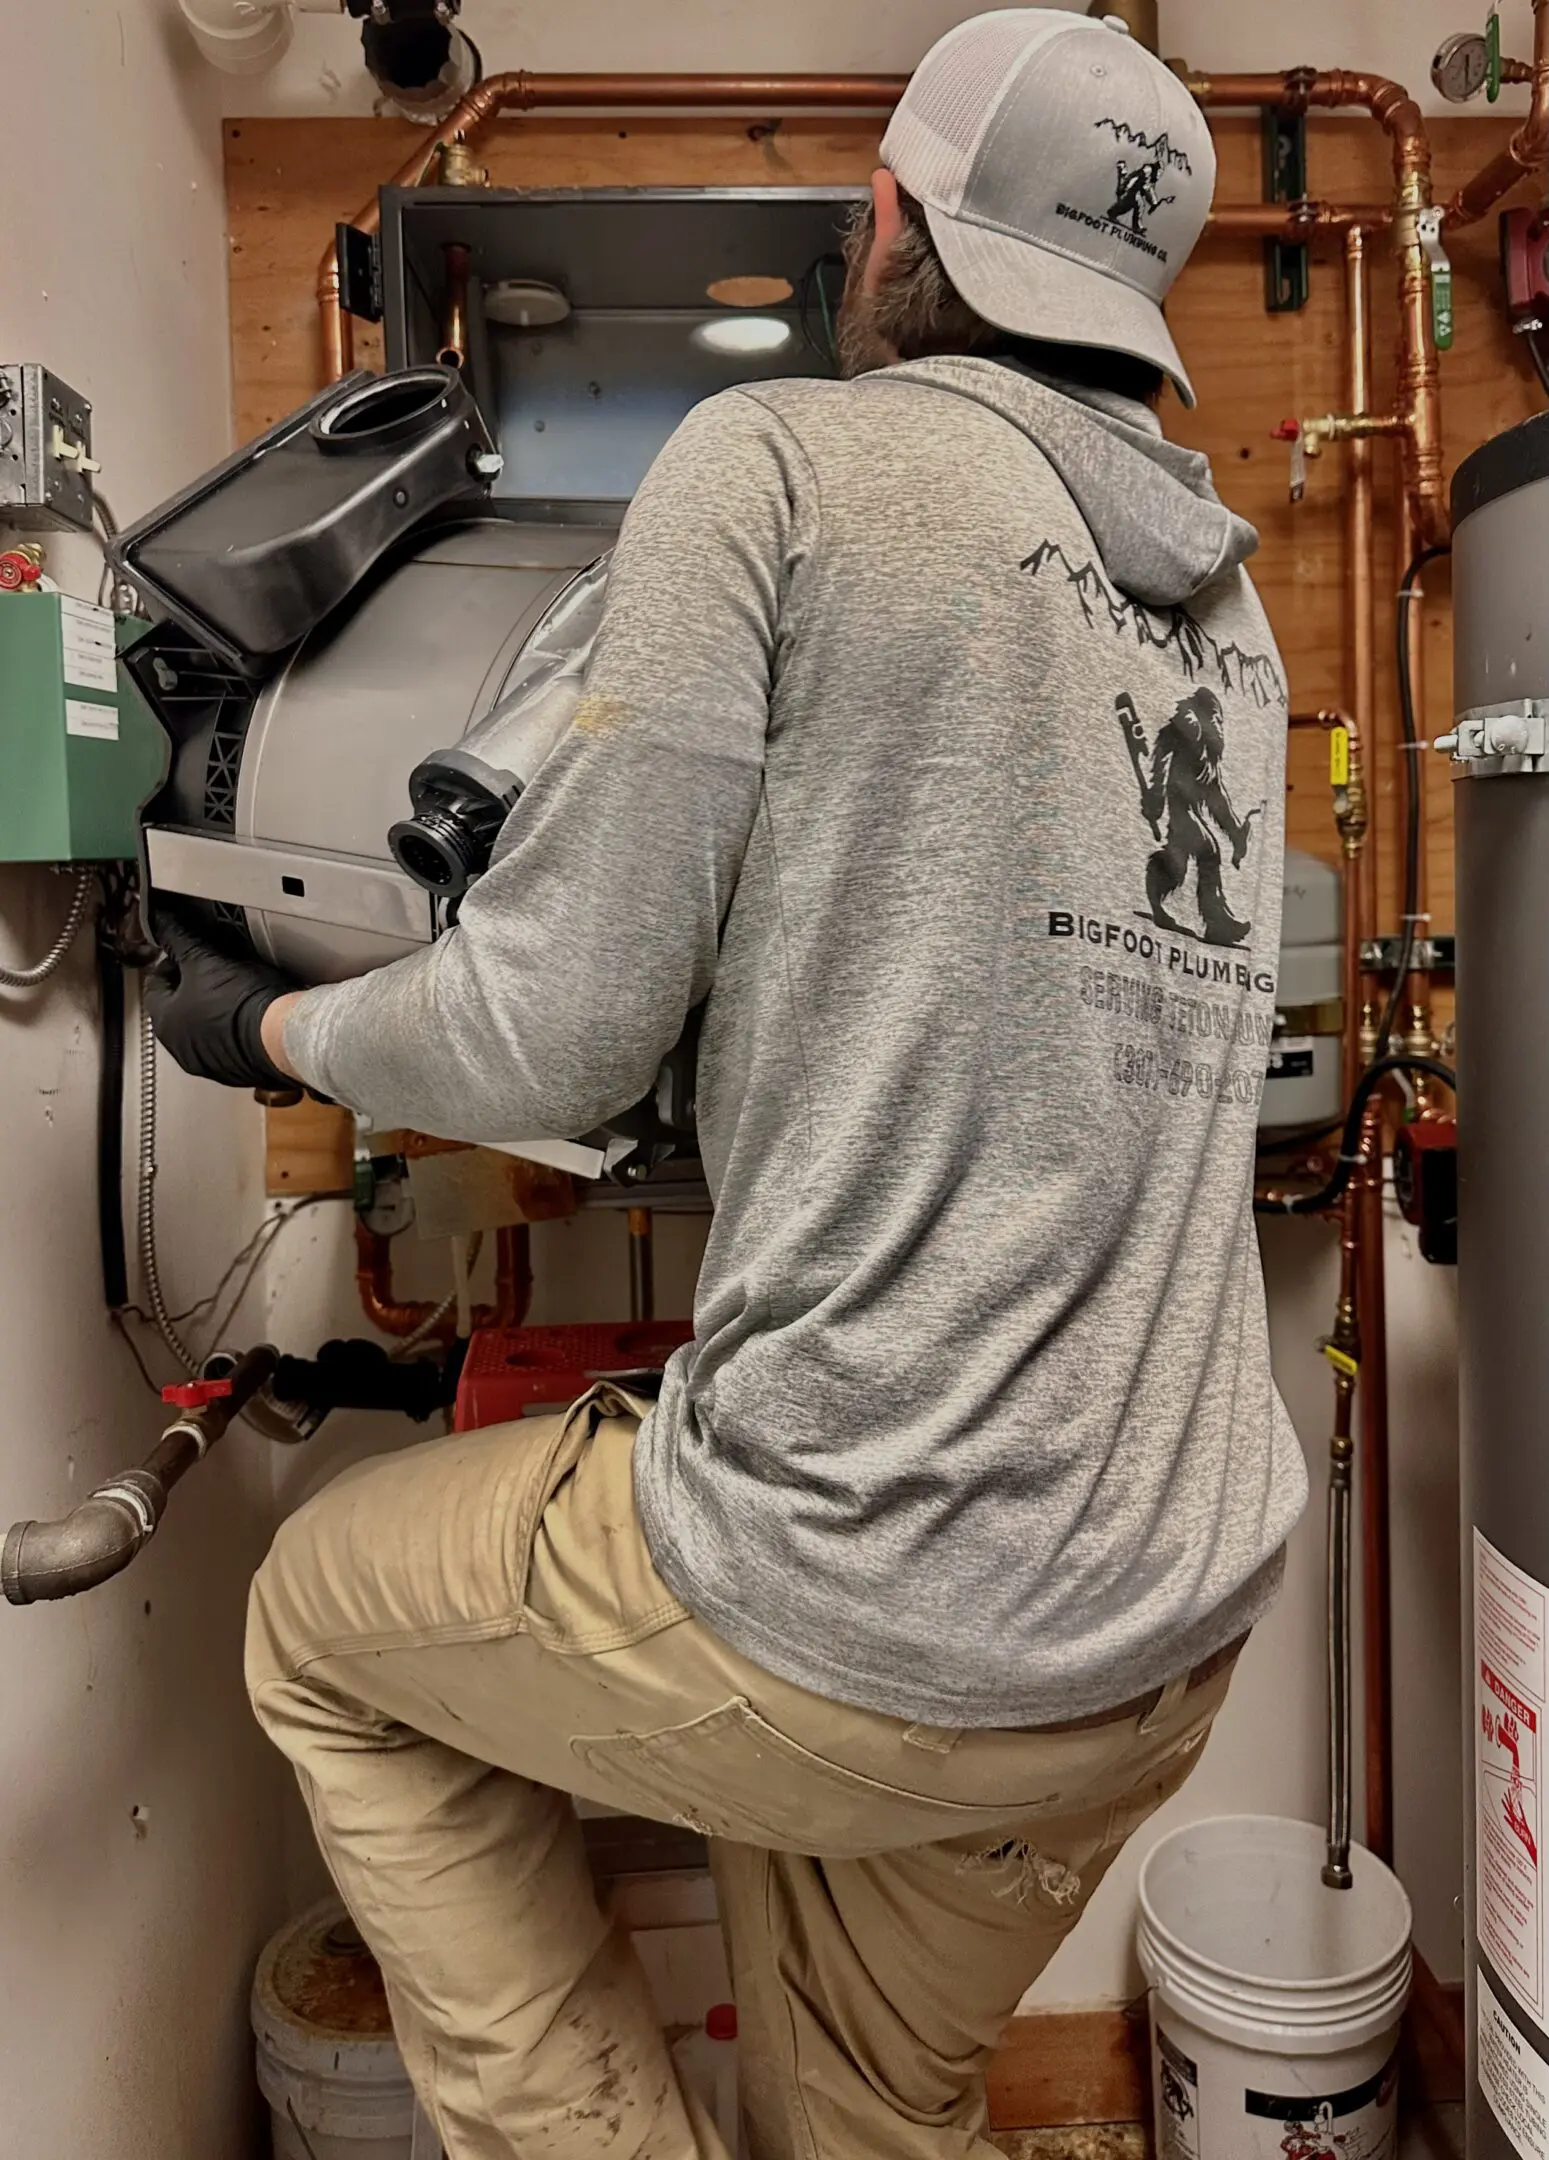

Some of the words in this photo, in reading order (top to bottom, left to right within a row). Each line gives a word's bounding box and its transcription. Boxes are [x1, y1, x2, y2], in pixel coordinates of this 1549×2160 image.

[1056, 202, 1109, 233] BIGFOOT
[1110, 225, 1158, 256] PLUMBING
[1048, 911, 1163, 964] BIGFOOT
[1080, 965, 1165, 1026] SERVING
[1494, 1681, 1531, 1726] DANGER
[1493, 2009, 1521, 2056] CAUTION
